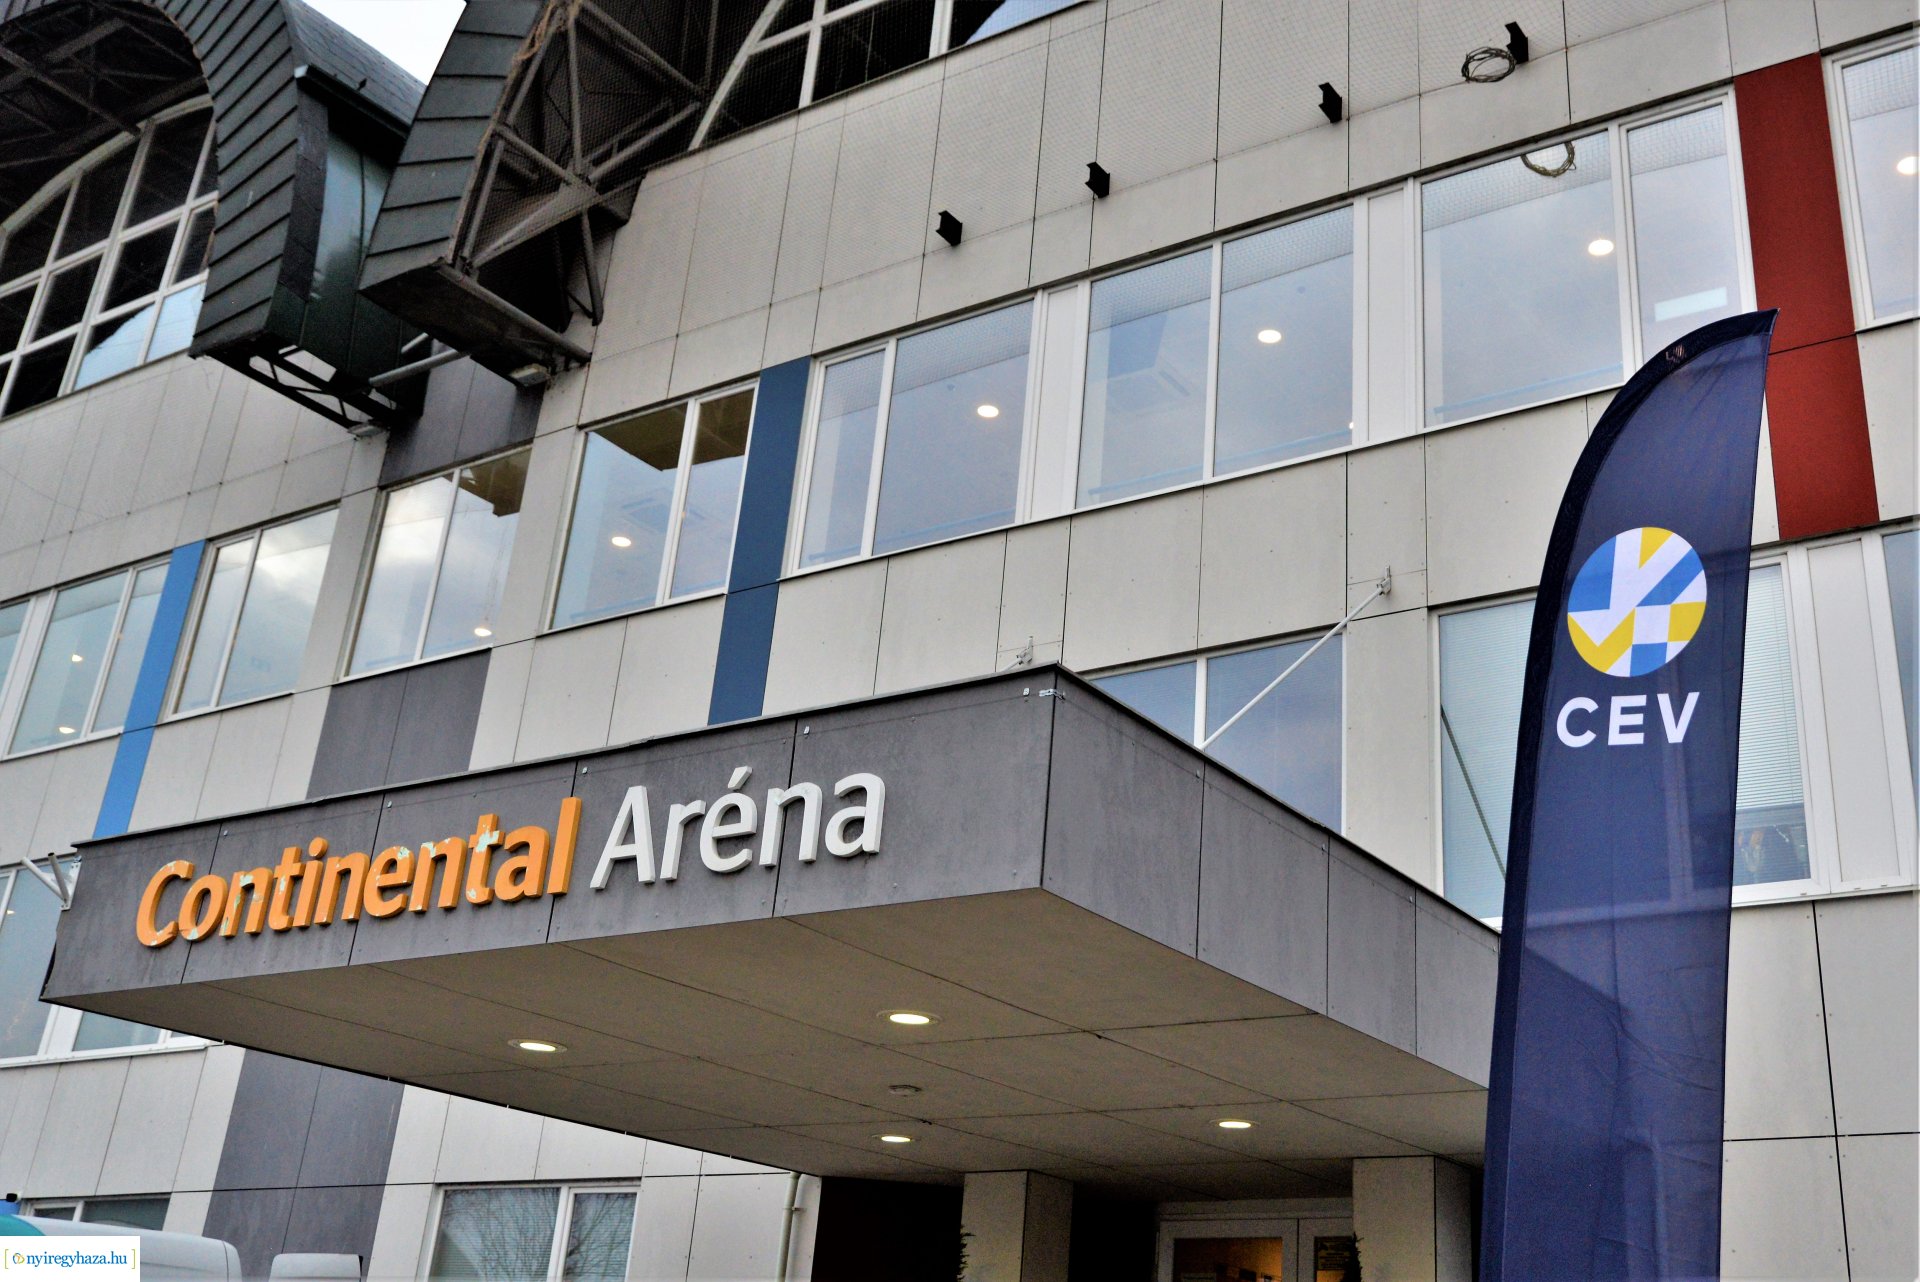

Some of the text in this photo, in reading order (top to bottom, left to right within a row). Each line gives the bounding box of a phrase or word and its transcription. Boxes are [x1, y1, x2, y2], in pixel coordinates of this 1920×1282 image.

[1557, 692, 1700, 748] CEV
[136, 765, 886, 948] Continental Aréna
